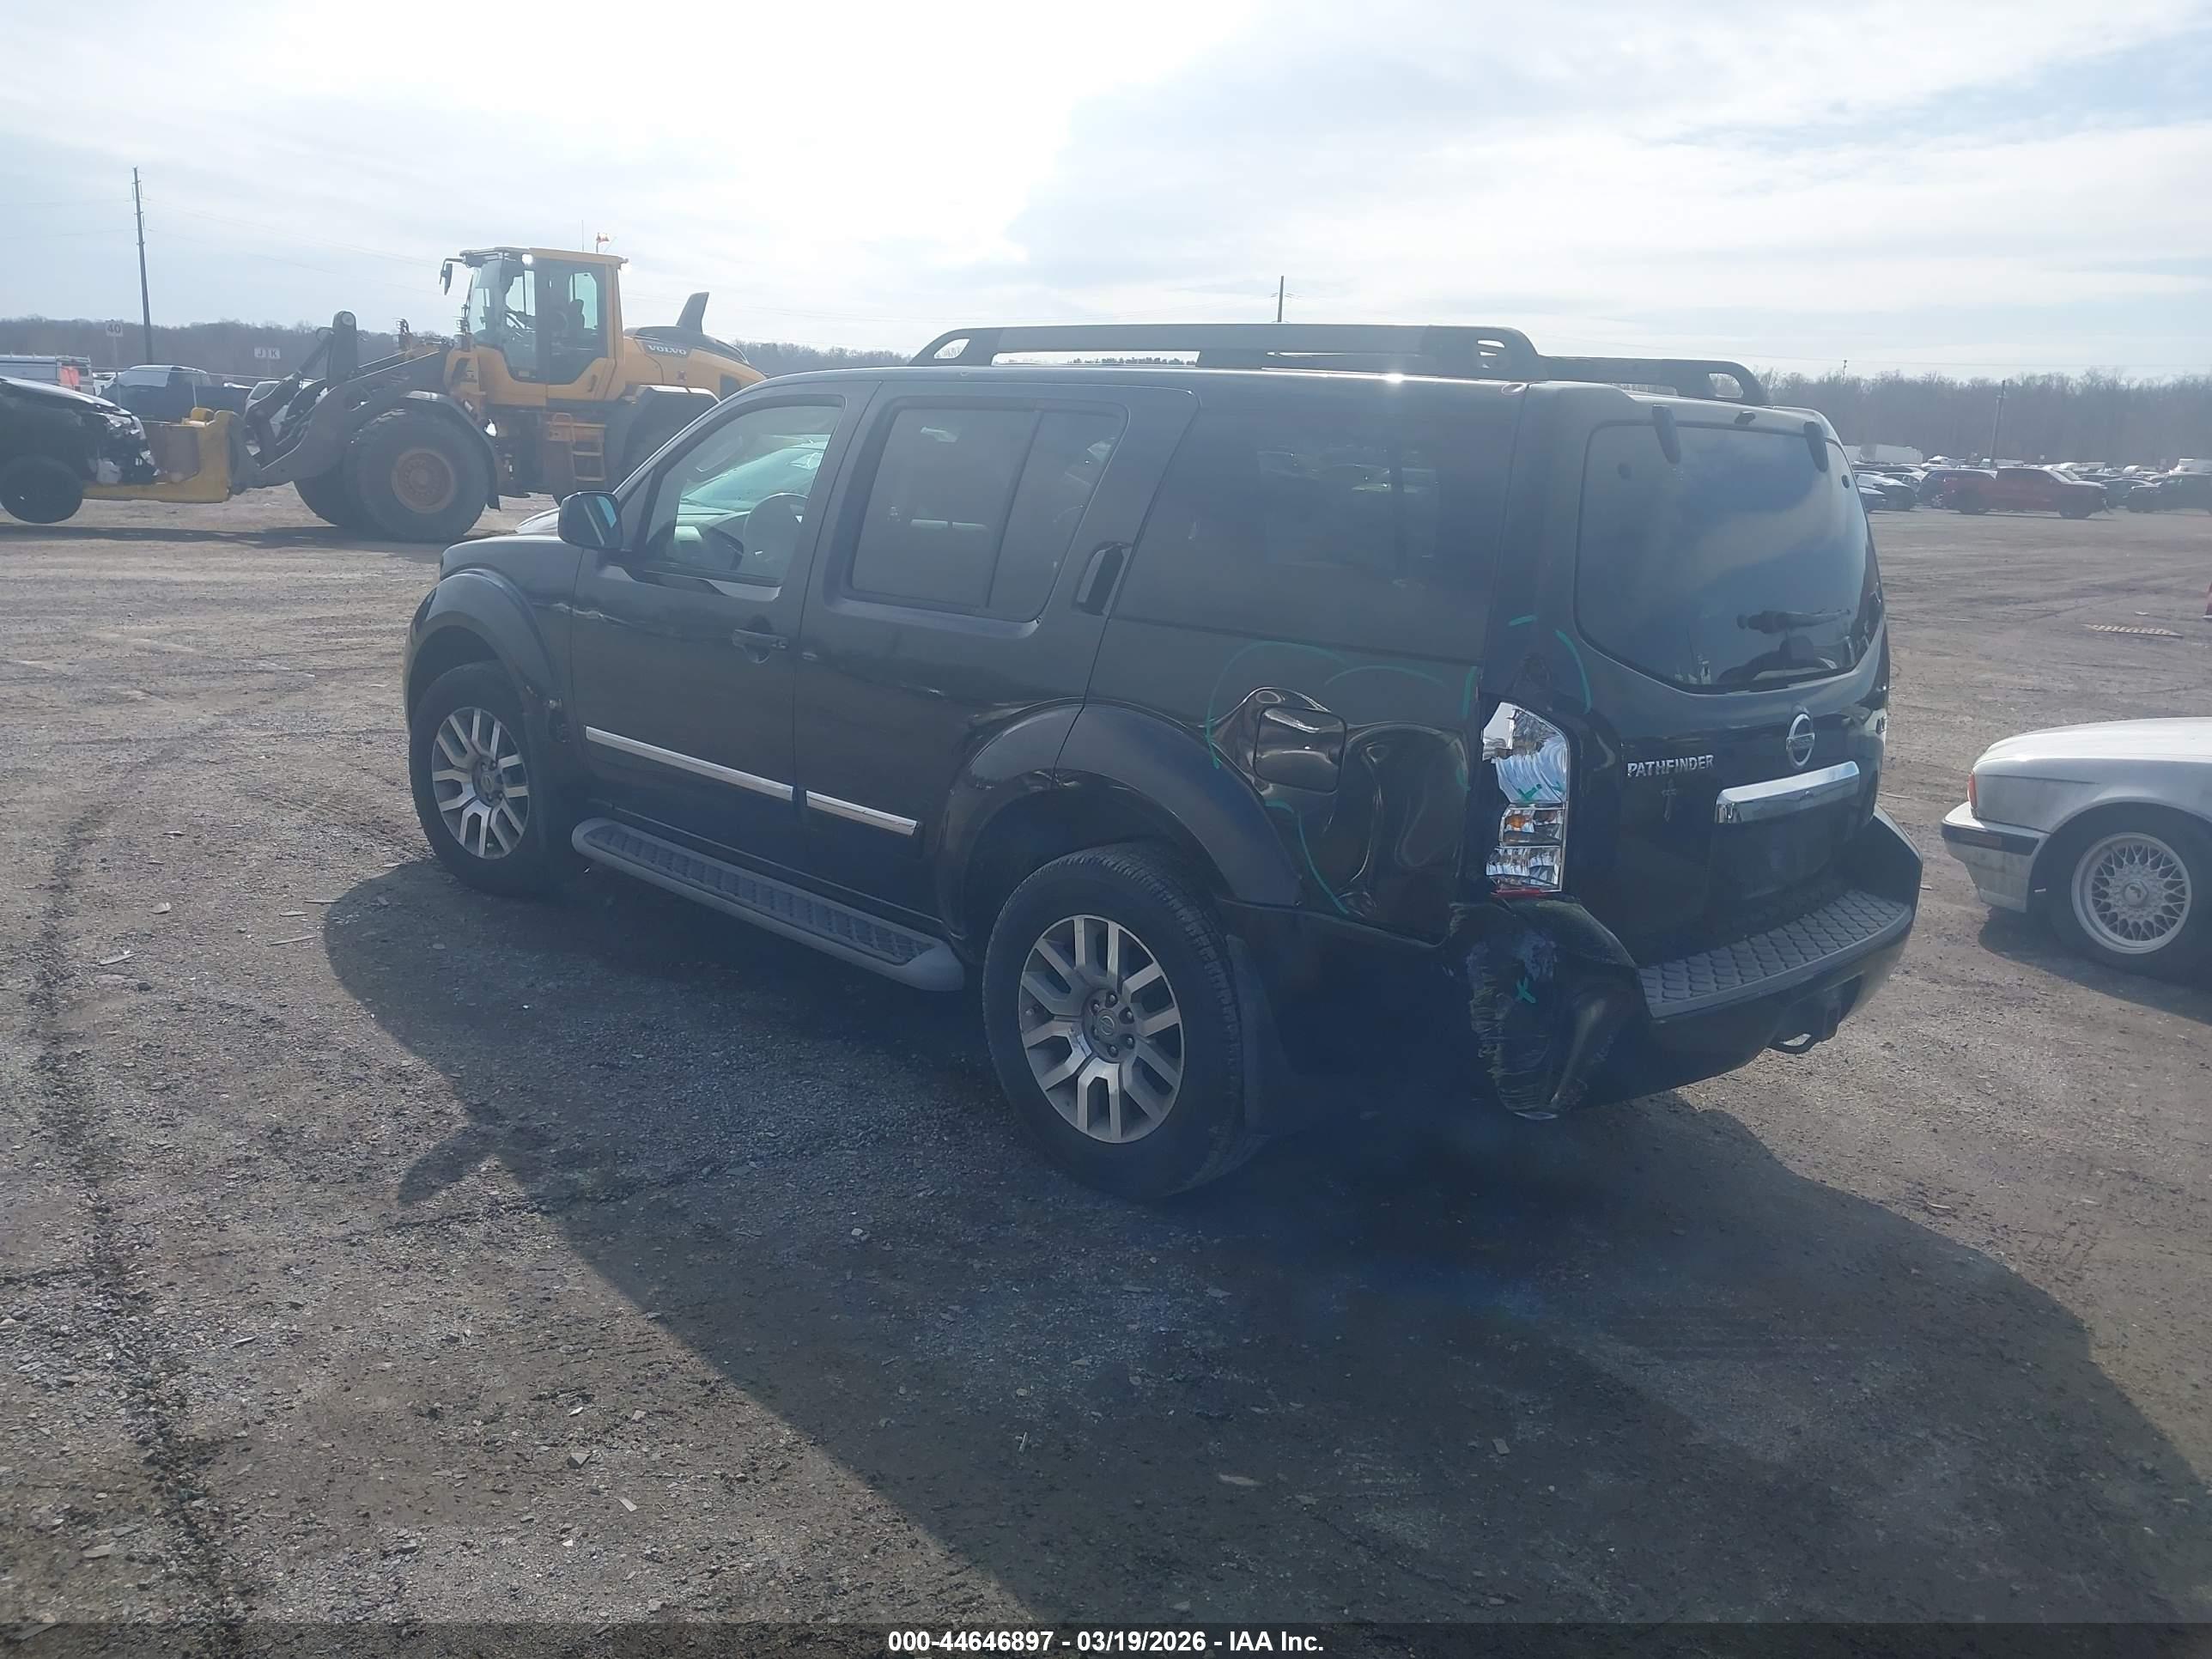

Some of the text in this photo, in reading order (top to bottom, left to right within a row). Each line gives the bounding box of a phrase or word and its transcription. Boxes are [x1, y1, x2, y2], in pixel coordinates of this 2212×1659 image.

[106, 324, 121, 333] 40
[647, 344, 687, 356] VOLVO
[1627, 754, 1715, 777] PATHFINDER
